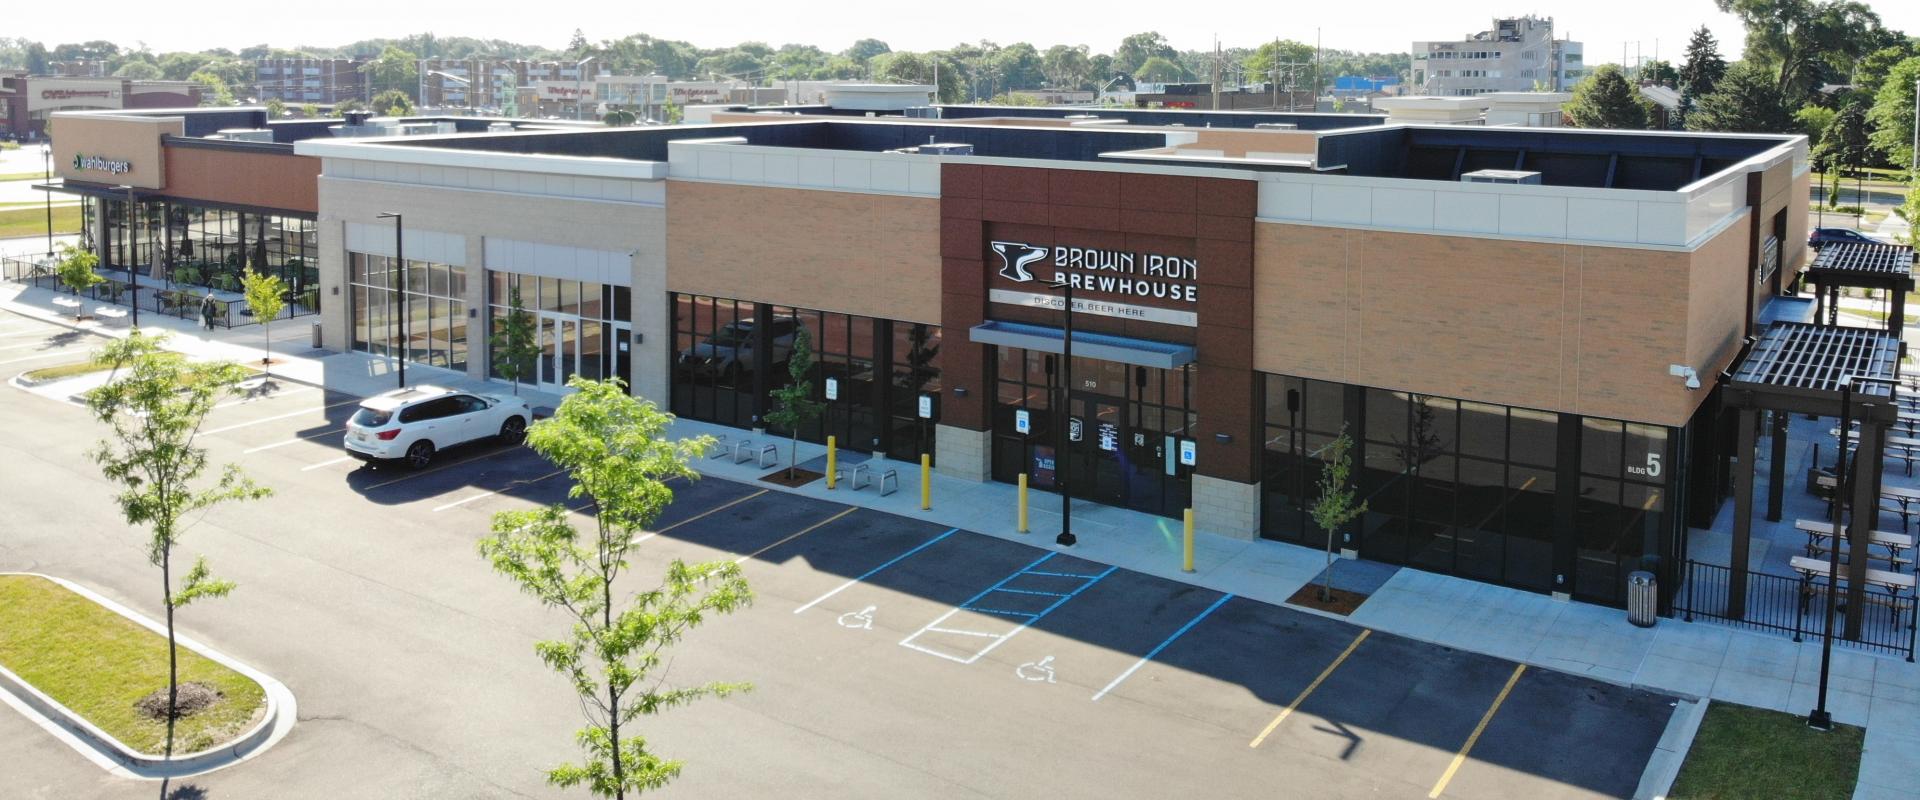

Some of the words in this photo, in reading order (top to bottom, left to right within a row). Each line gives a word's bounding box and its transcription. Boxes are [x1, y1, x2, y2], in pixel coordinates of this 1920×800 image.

[80, 156, 129, 175] wahlburgers
[1055, 246, 1134, 273] BROWN
[1143, 254, 1197, 280] IRON
[1055, 272, 1197, 302] BREWHOUSE
[1034, 297, 1084, 310] DISCOER
[1087, 304, 1114, 313] BEER
[1118, 308, 1145, 318] HERE
[1084, 380, 1097, 388] 510
[1627, 465, 1646, 475] BLDG
[1646, 452, 1661, 477] 5
